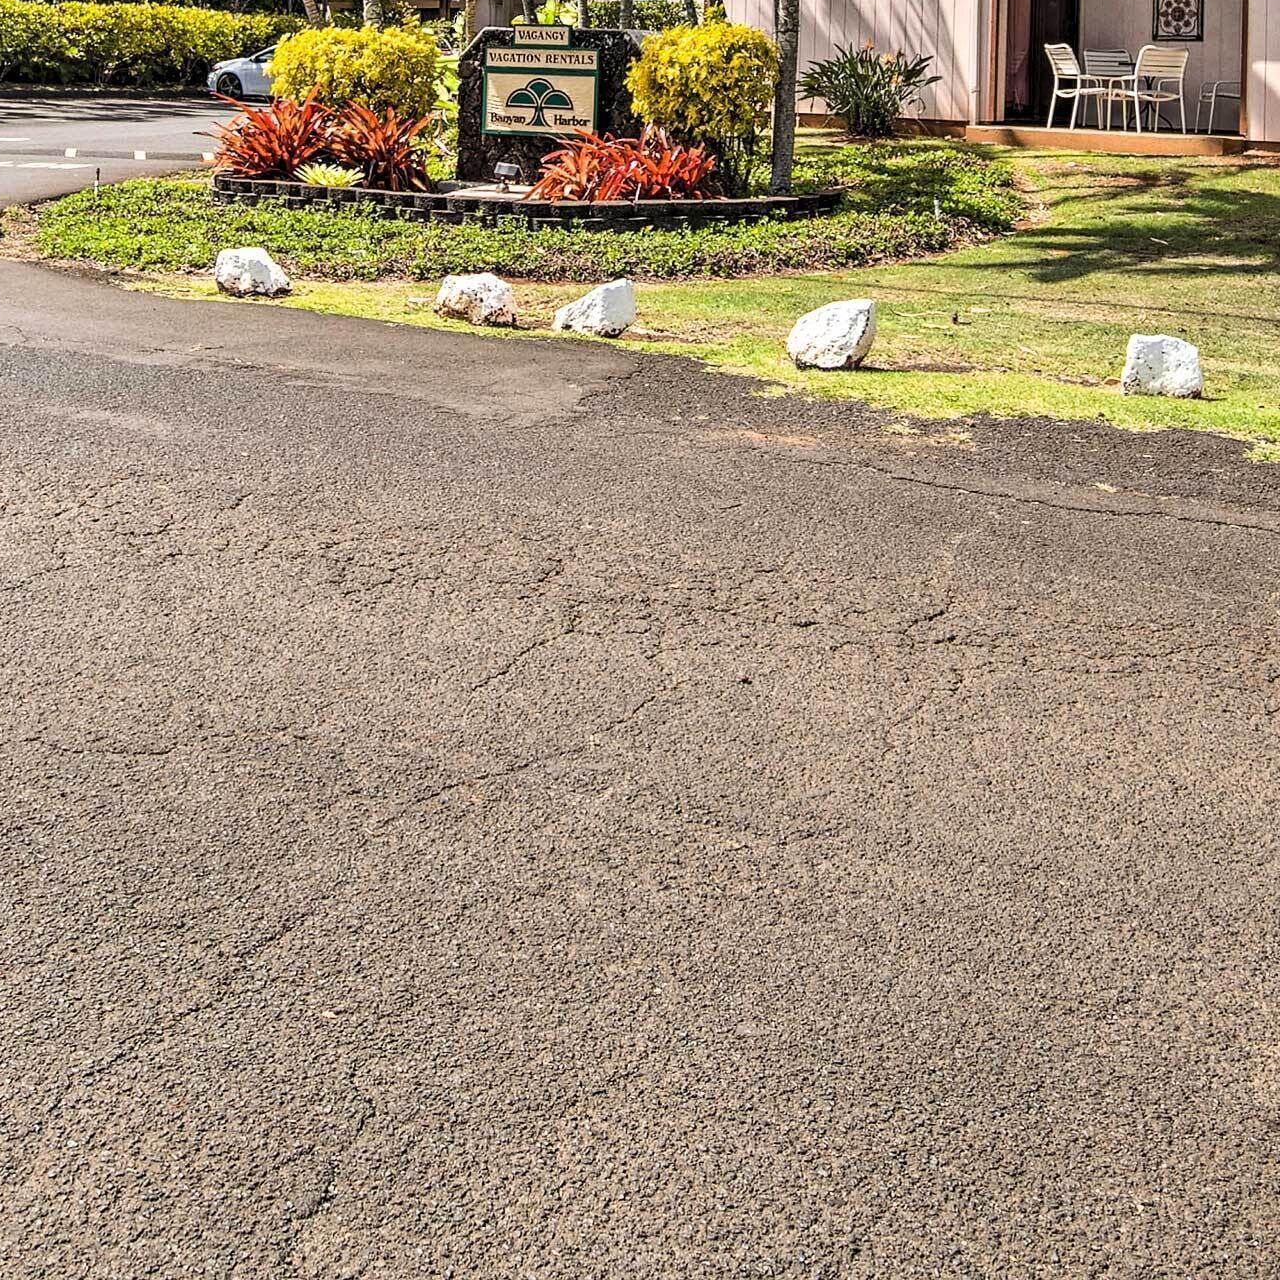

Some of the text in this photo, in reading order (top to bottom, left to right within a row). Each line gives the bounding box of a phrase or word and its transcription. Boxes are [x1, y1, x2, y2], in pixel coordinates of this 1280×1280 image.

[545, 54, 594, 65] RENTALS
[489, 112, 591, 127] Banyan Harbor
